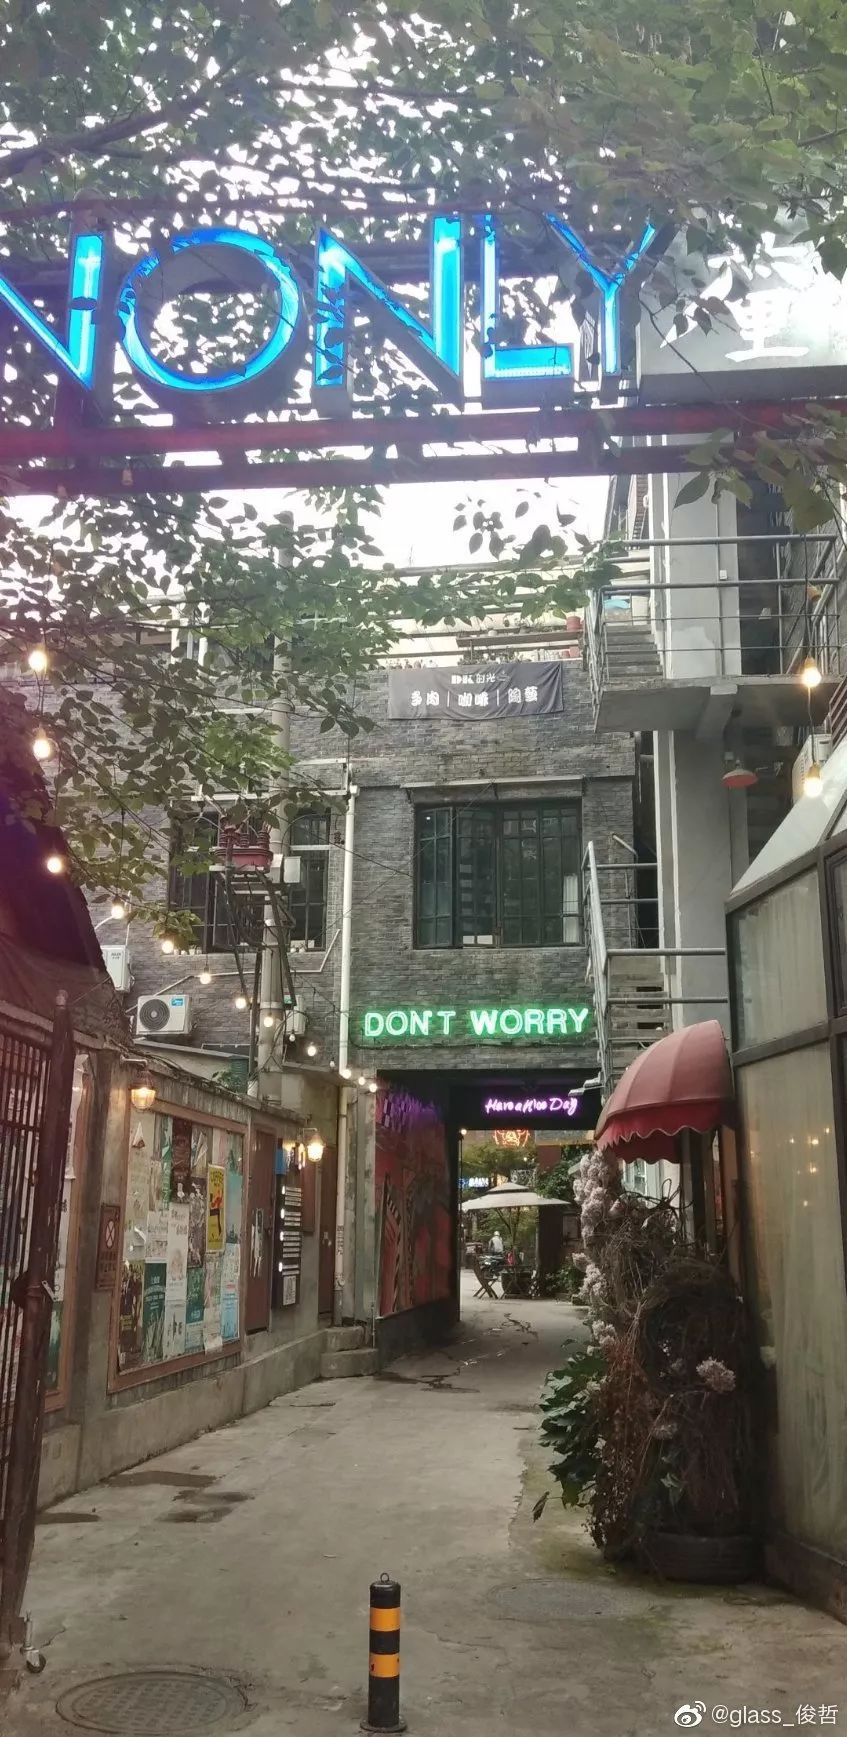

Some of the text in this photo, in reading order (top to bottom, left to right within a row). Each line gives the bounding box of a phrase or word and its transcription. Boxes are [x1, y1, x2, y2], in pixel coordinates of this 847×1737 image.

[459, 692, 489, 706] 咖啡
[471, 1007, 589, 1034] WORRY
[486, 1098, 514, 1114] Have
[523, 1098, 547, 1113] Nice
[549, 1097, 578, 1116] Day
